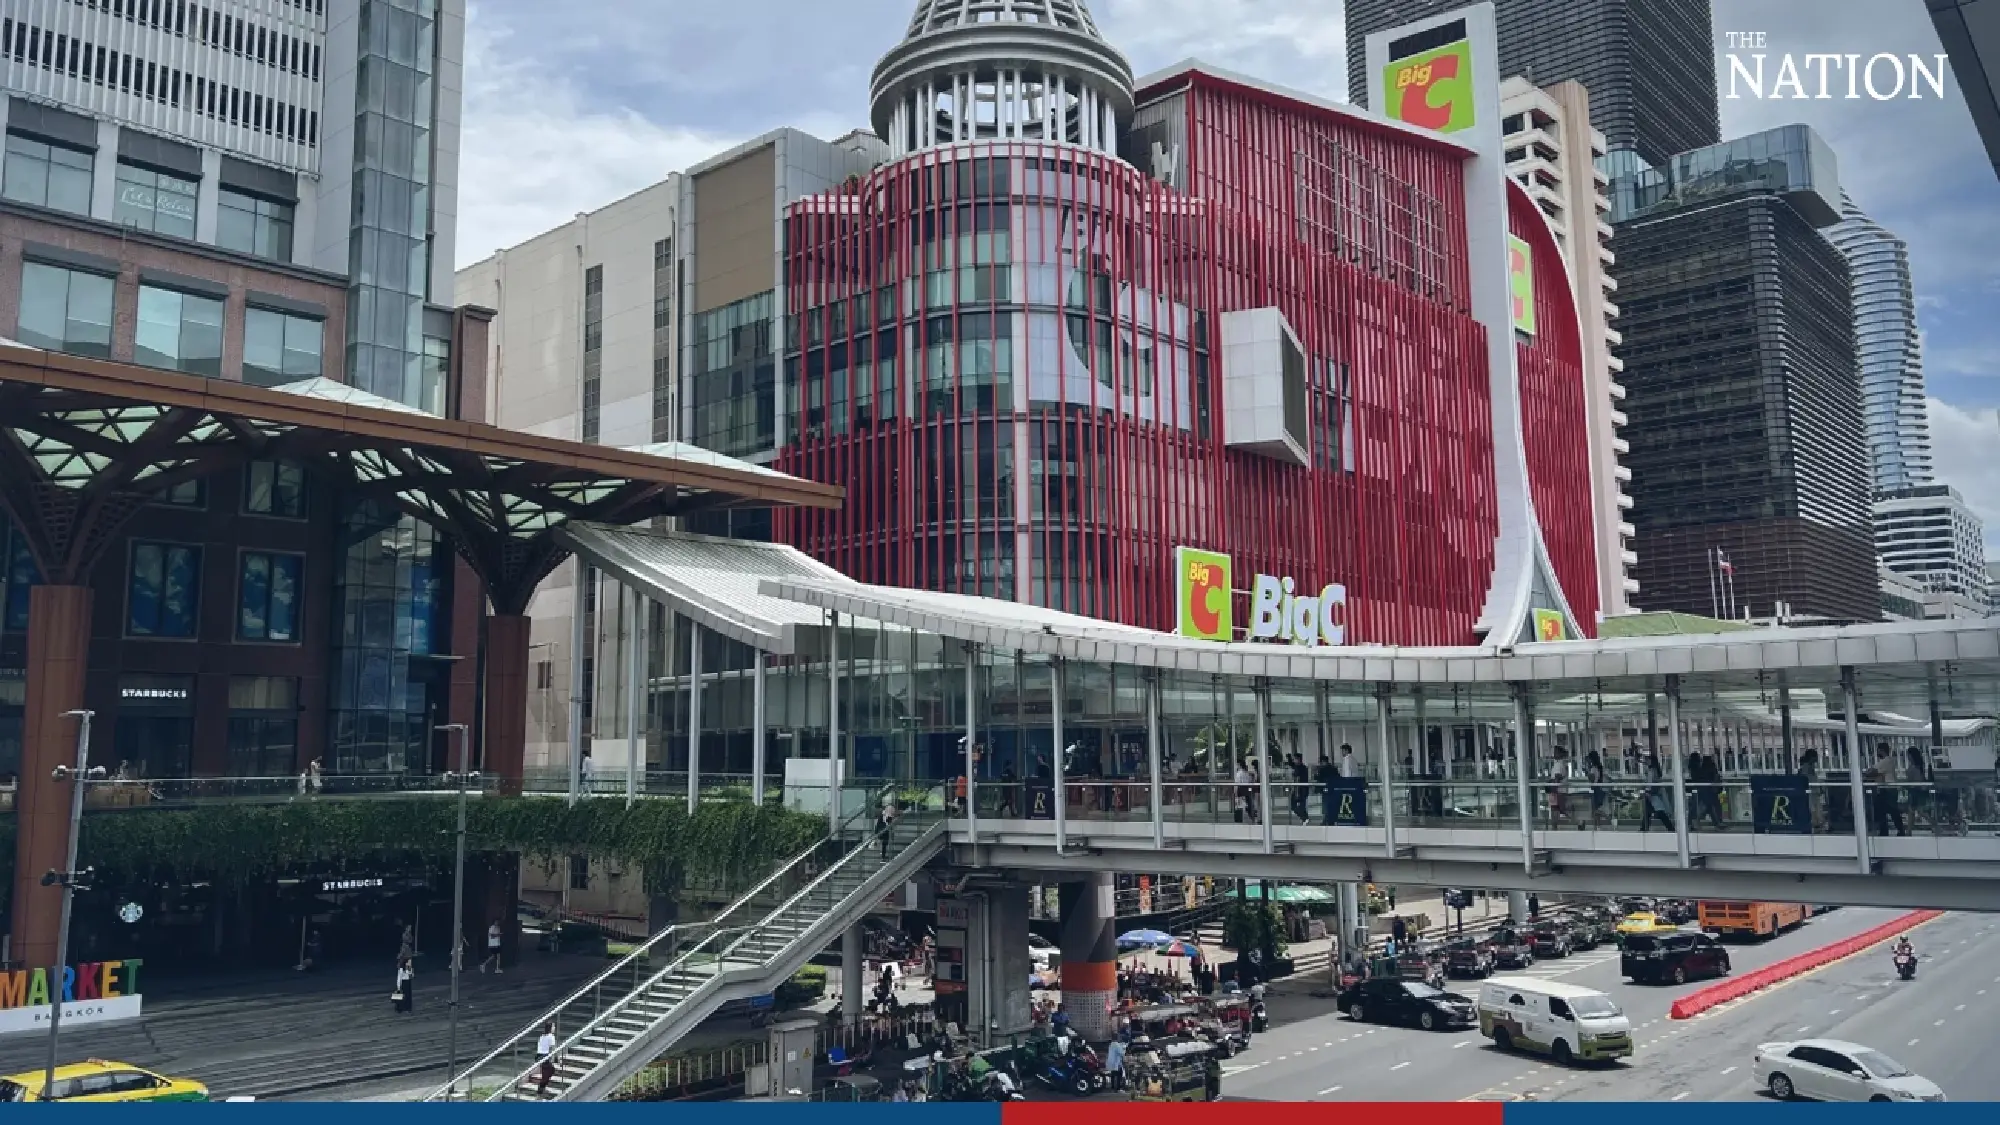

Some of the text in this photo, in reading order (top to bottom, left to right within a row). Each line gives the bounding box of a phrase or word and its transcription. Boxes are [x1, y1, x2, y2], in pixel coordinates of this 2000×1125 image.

[1396, 54, 1459, 130] Big C
[1189, 561, 1224, 635] Big C
[121, 688, 188, 698] STARBUCKS
[1340, 793, 1353, 814] R
[1771, 795, 1791, 820] R
[322, 879, 383, 891] STARBUCKS
[34, 1005, 105, 1023] BAGKOK
